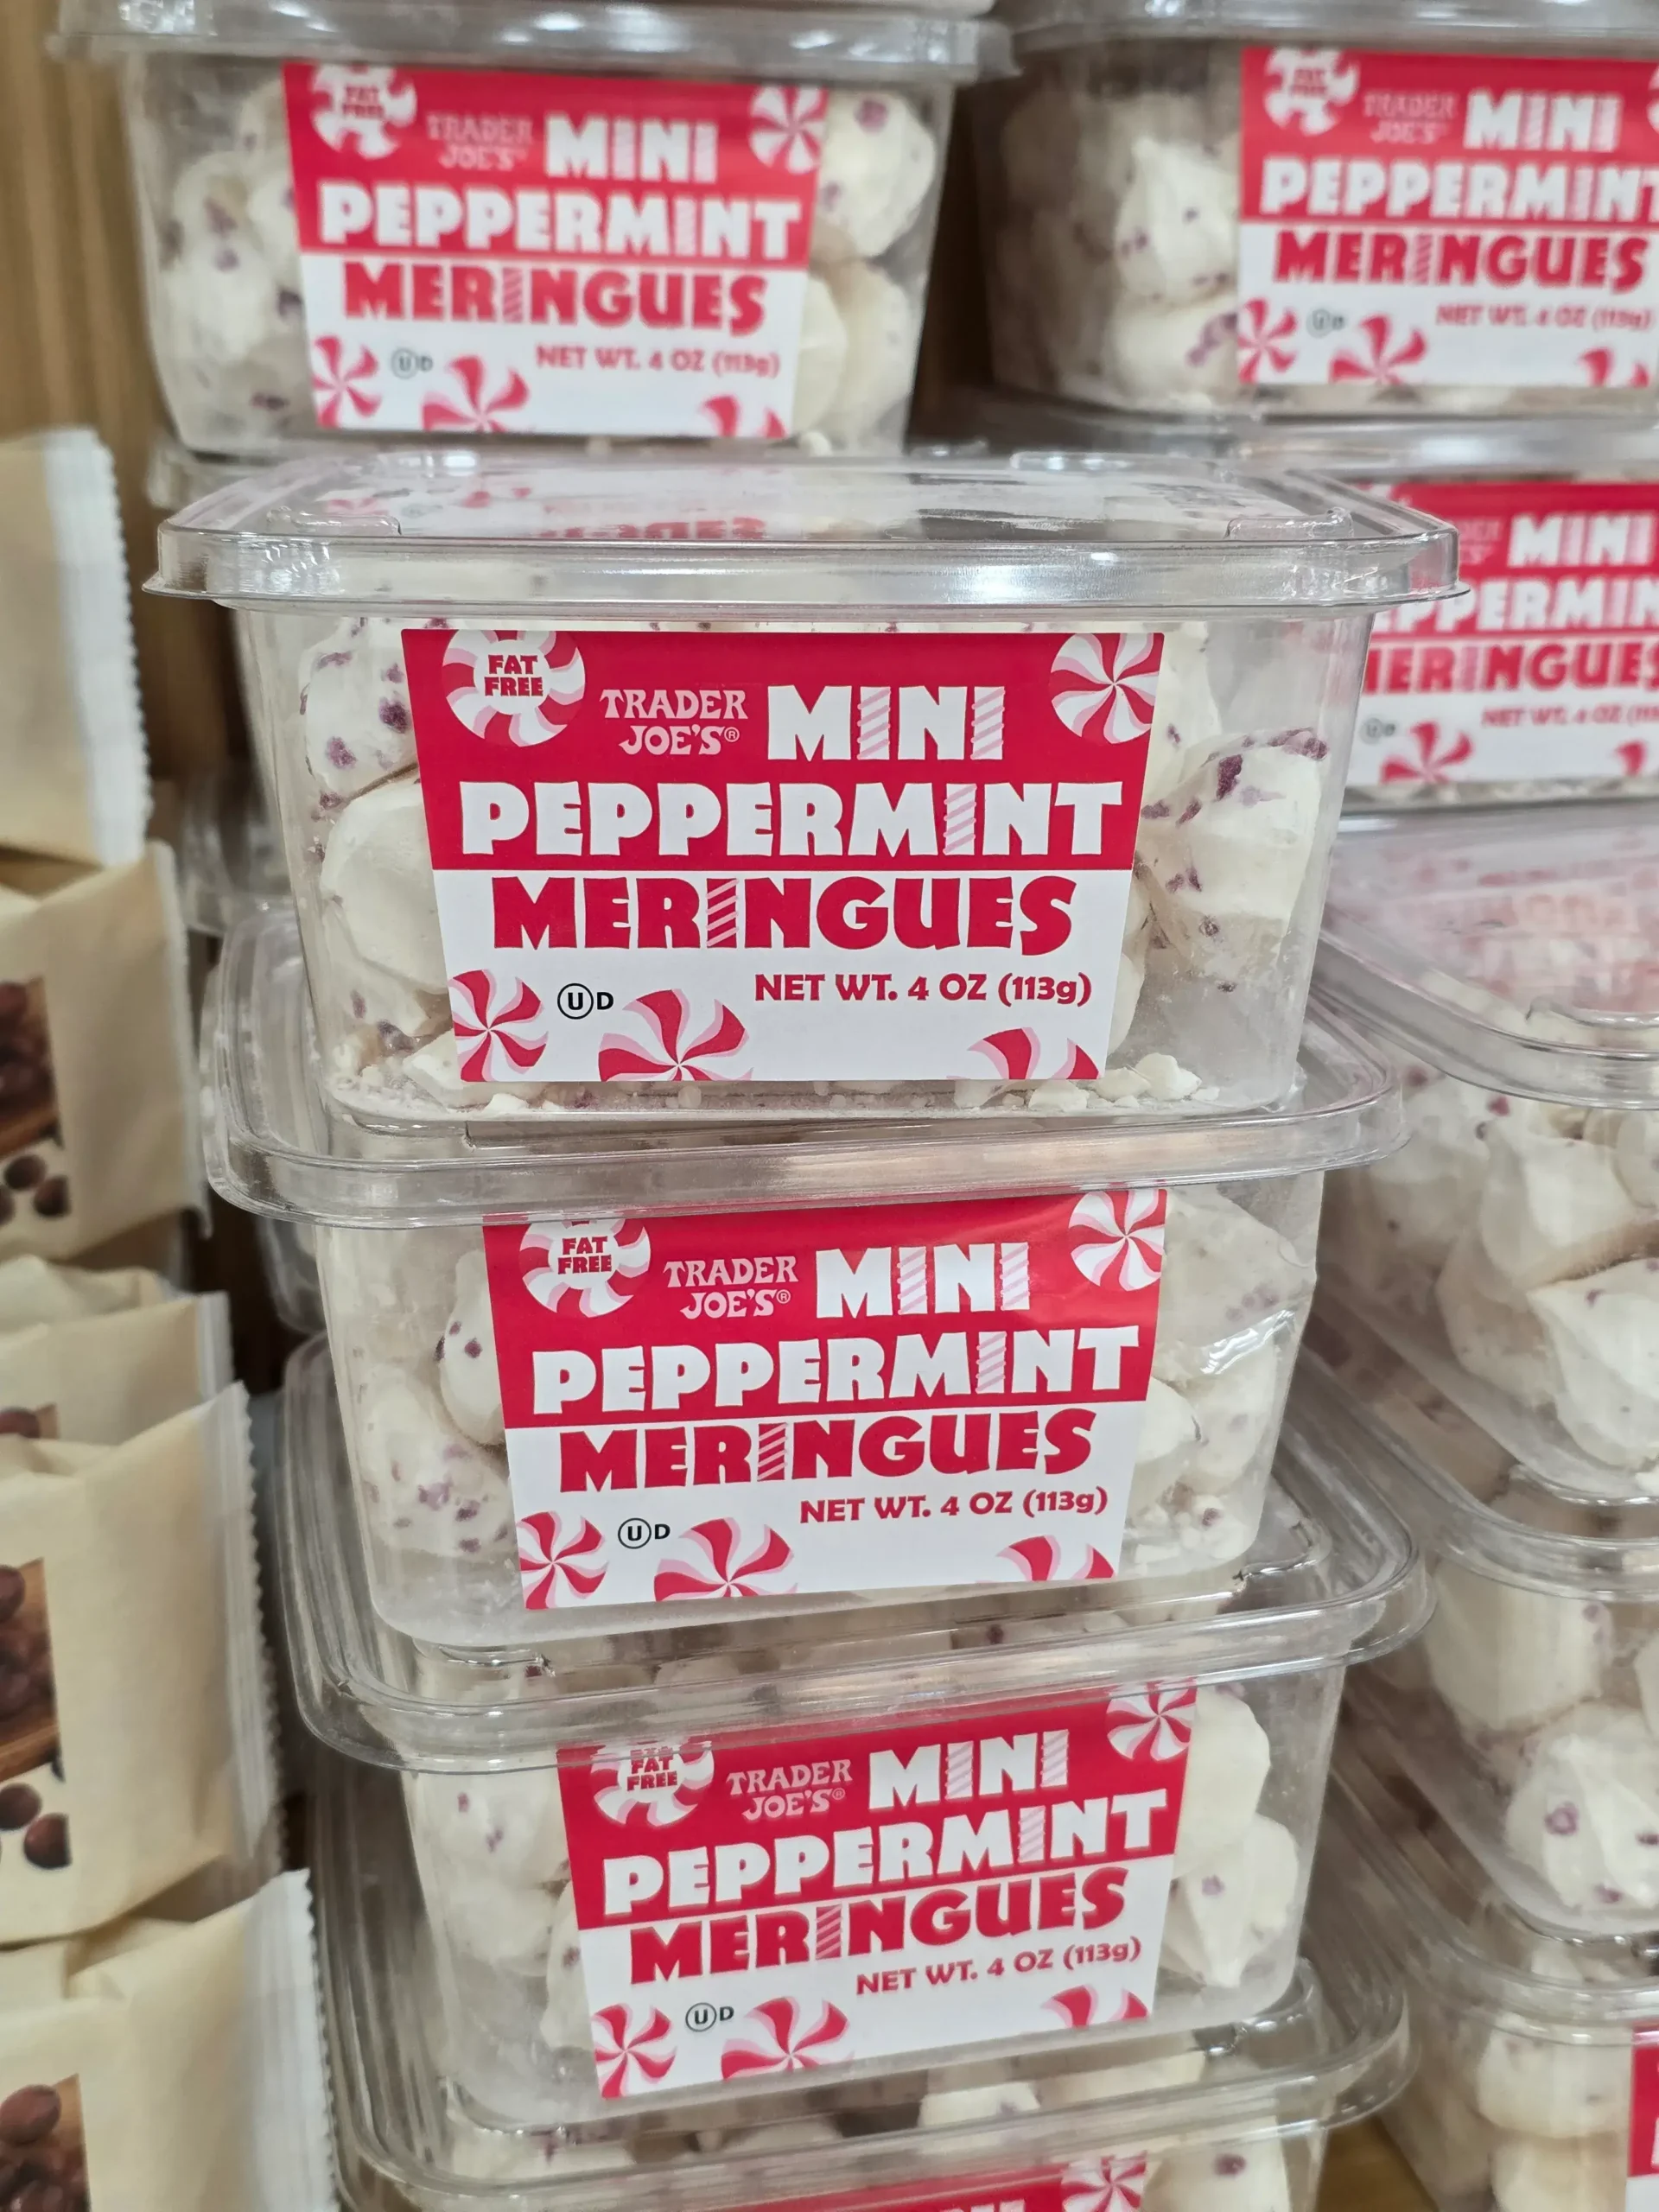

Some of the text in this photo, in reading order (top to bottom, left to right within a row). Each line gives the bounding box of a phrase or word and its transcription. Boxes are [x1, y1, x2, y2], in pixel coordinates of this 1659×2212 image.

[427, 112, 533, 145] TRADER
[545, 111, 719, 184] MINI
[1464, 89, 1623, 152] MINI
[319, 181, 802, 259] PEPPERMINT
[1274, 229, 1649, 295] MERINGUES
[342, 260, 768, 337] MERINGUES
[536, 344, 587, 370] NET
[649, 349, 663, 371] 4
[669, 347, 705, 372] OZ
[1508, 512, 1655, 568] MINI
[484, 676, 543, 697] FREE
[487, 654, 538, 675] FAT
[599, 689, 748, 720] TRADER
[767, 684, 1006, 761] MINI
[460, 781, 1122, 858] PEPPERMINT
[492, 876, 1077, 956] MERINGUES
[754, 973, 1091, 1007] NET WT. 4 OZ (113g)
[557, 1254, 612, 1275] FREE
[563, 1236, 608, 1255] FAT
[663, 1255, 799, 1288] TRADER
[816, 1242, 1030, 1318] MINI
[531, 1325, 1139, 1415] PEPPERMINT
[559, 1408, 1097, 1492] MERINGUES
[800, 1485, 1108, 1523] NET WT. 4 OZ (113g)
[626, 1770, 678, 1791] FREE
[631, 1755, 673, 1774] FAT
[726, 1758, 853, 1796] TRADER
[868, 1729, 1070, 1811] MINI
[603, 1789, 1167, 1917] PEPPERMINT
[630, 1867, 1129, 1985] MERINGUES
[856, 1936, 1141, 1996] NET WT. 4 OZ (113g)
